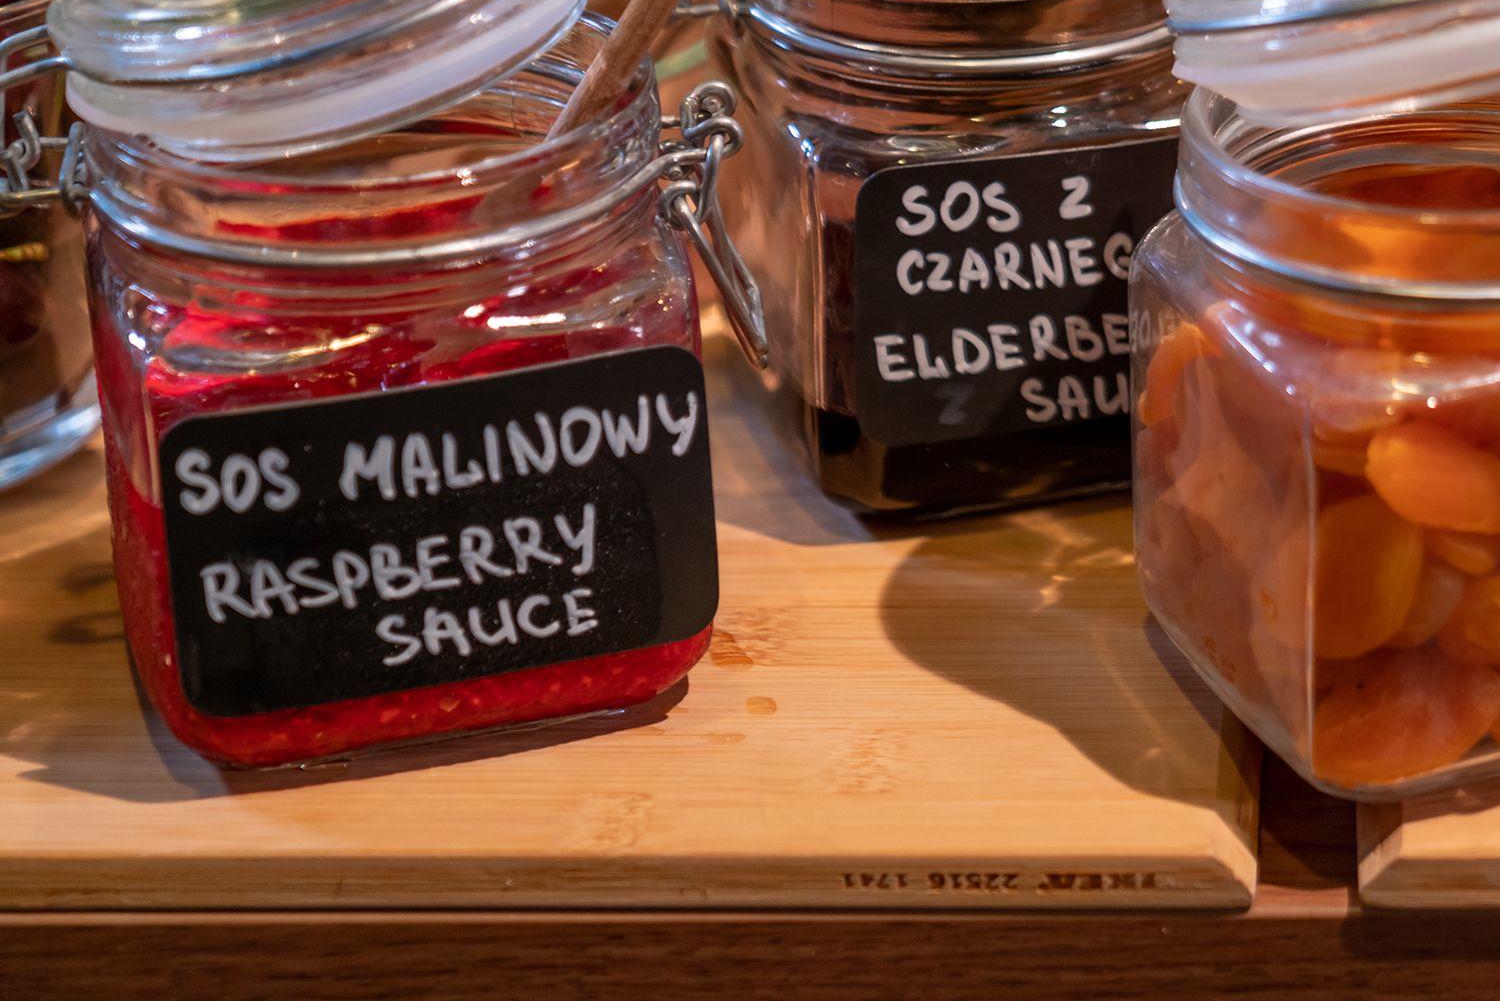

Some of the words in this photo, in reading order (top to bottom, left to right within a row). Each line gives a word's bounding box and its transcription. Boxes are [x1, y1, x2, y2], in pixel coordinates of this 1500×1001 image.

[896, 181, 1021, 236] SOS
[1059, 176, 1093, 220] Z
[176, 448, 300, 514] SOS
[339, 392, 698, 500] MALINOWY
[201, 503, 597, 623] RASPBERRY
[375, 589, 597, 666] SAUCE
[841, 872, 907, 889] 1741
[928, 872, 1018, 890] 22516
